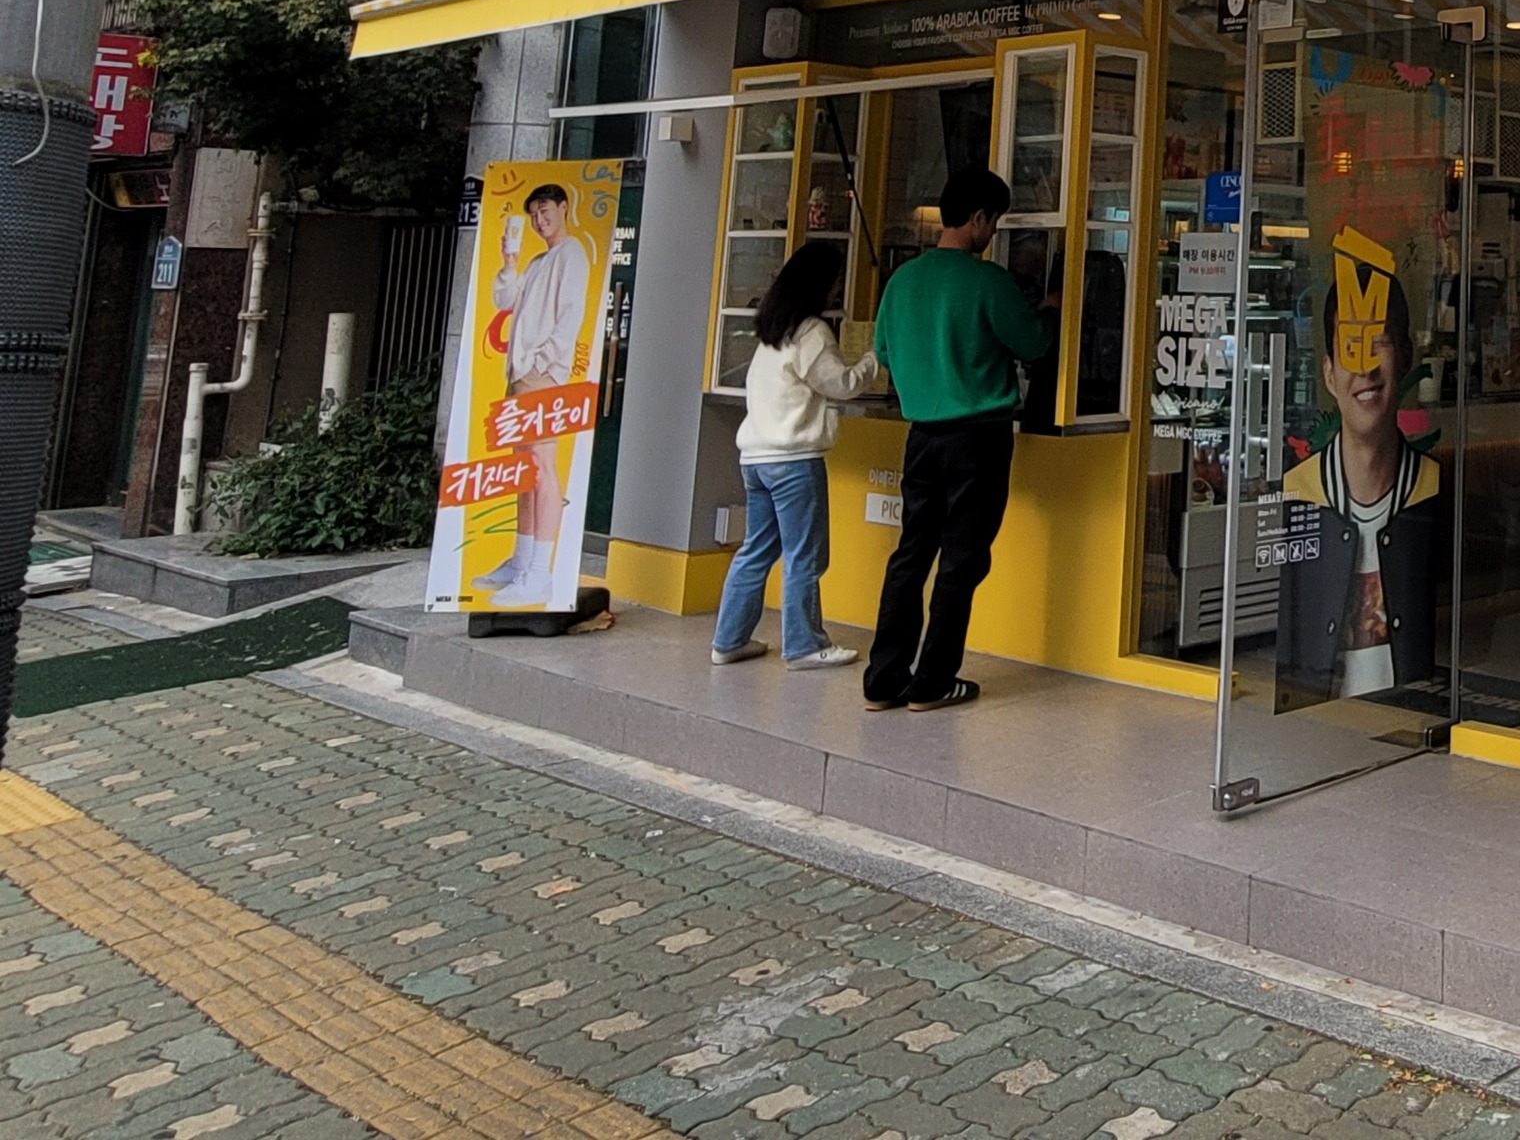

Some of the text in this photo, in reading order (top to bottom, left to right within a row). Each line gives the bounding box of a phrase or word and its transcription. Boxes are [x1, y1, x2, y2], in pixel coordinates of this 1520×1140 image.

[911, 16, 935, 33] 100%
[936, 9, 981, 30] ARABICA
[982, 4, 1021, 25] COFFEE
[615, 227, 636, 240] RBAN
[1201, 248, 1236, 263] 이용시간
[156, 262, 174, 283] 211
[1160, 294, 1229, 334] MEGA
[1154, 335, 1227, 390] SIZE
[494, 396, 591, 447] 즐거움이
[1153, 424, 1223, 443] MEGA MGC COFFEE
[446, 460, 530, 501] 커진다
